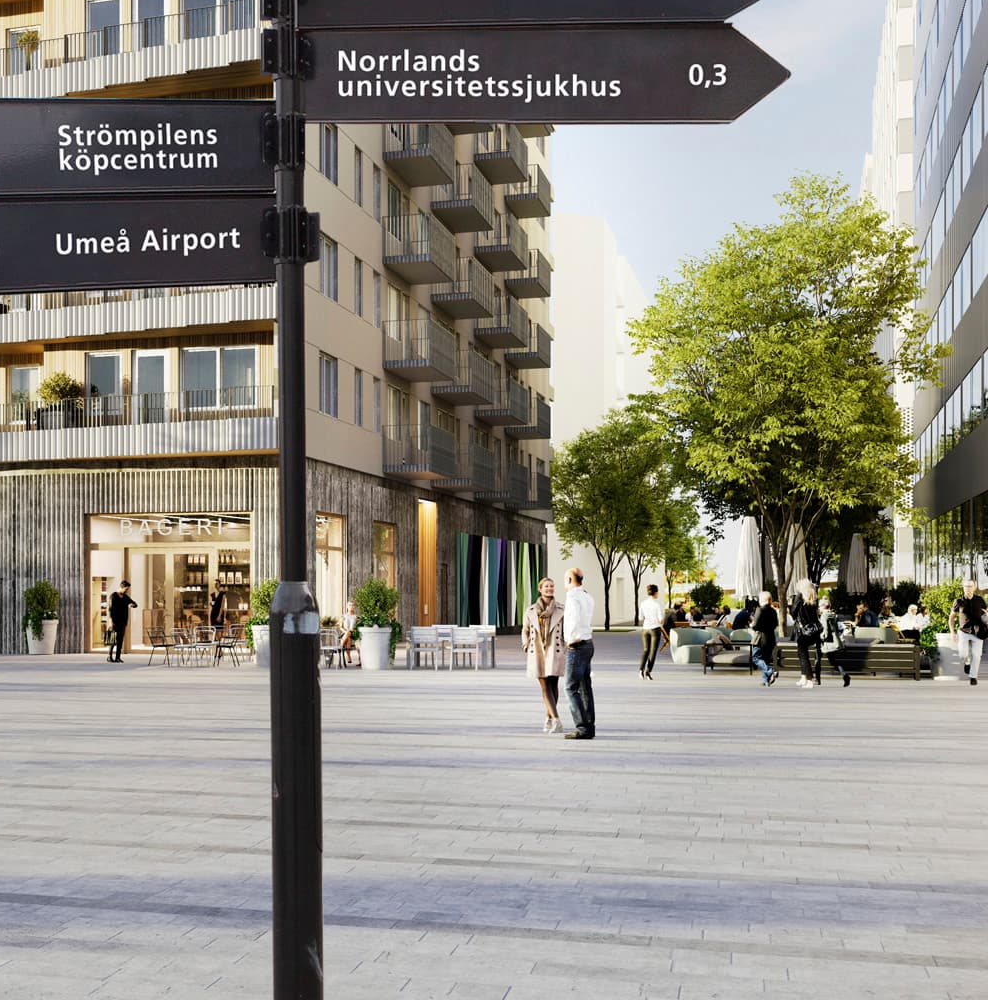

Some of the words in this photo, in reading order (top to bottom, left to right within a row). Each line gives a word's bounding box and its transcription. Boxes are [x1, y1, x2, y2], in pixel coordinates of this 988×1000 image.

[338, 48, 480, 72] Norrlands
[338, 73, 622, 103] universitetssjukhus
[688, 63, 727, 89] 0,3
[57, 122, 218, 152] Strömpilens
[58, 147, 218, 176] köpcentrum
[55, 228, 130, 255] Umeå
[141, 228, 241, 257] Airport
[120, 518, 223, 536] BAGERI
